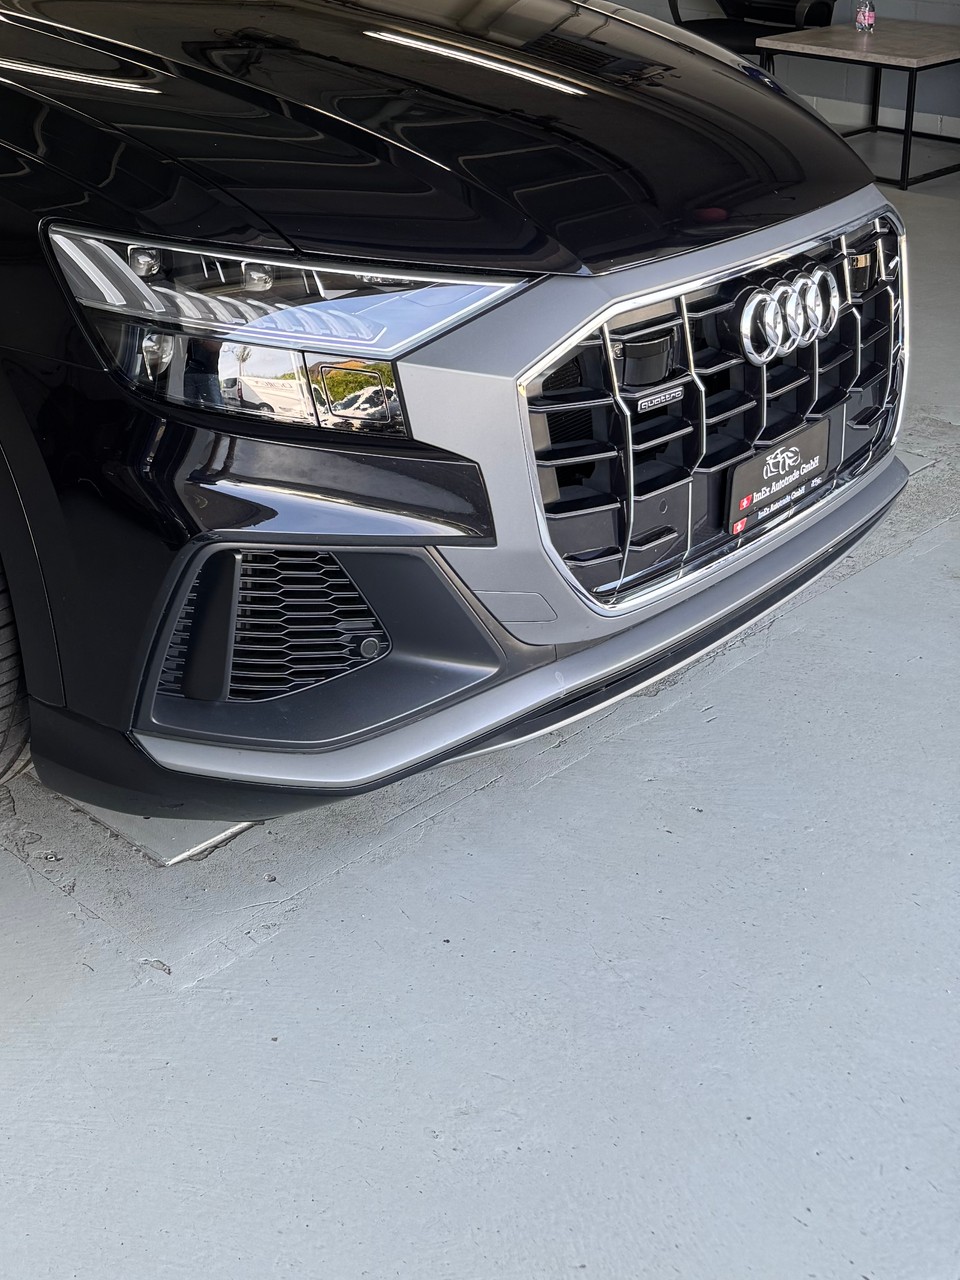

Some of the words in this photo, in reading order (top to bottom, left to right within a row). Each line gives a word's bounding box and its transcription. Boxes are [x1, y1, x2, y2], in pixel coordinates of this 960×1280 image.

[642, 391, 681, 410] quattro
[753, 487, 770, 503] ImEx
[771, 470, 799, 494] Autotrade
[800, 456, 819, 475] GmbH
